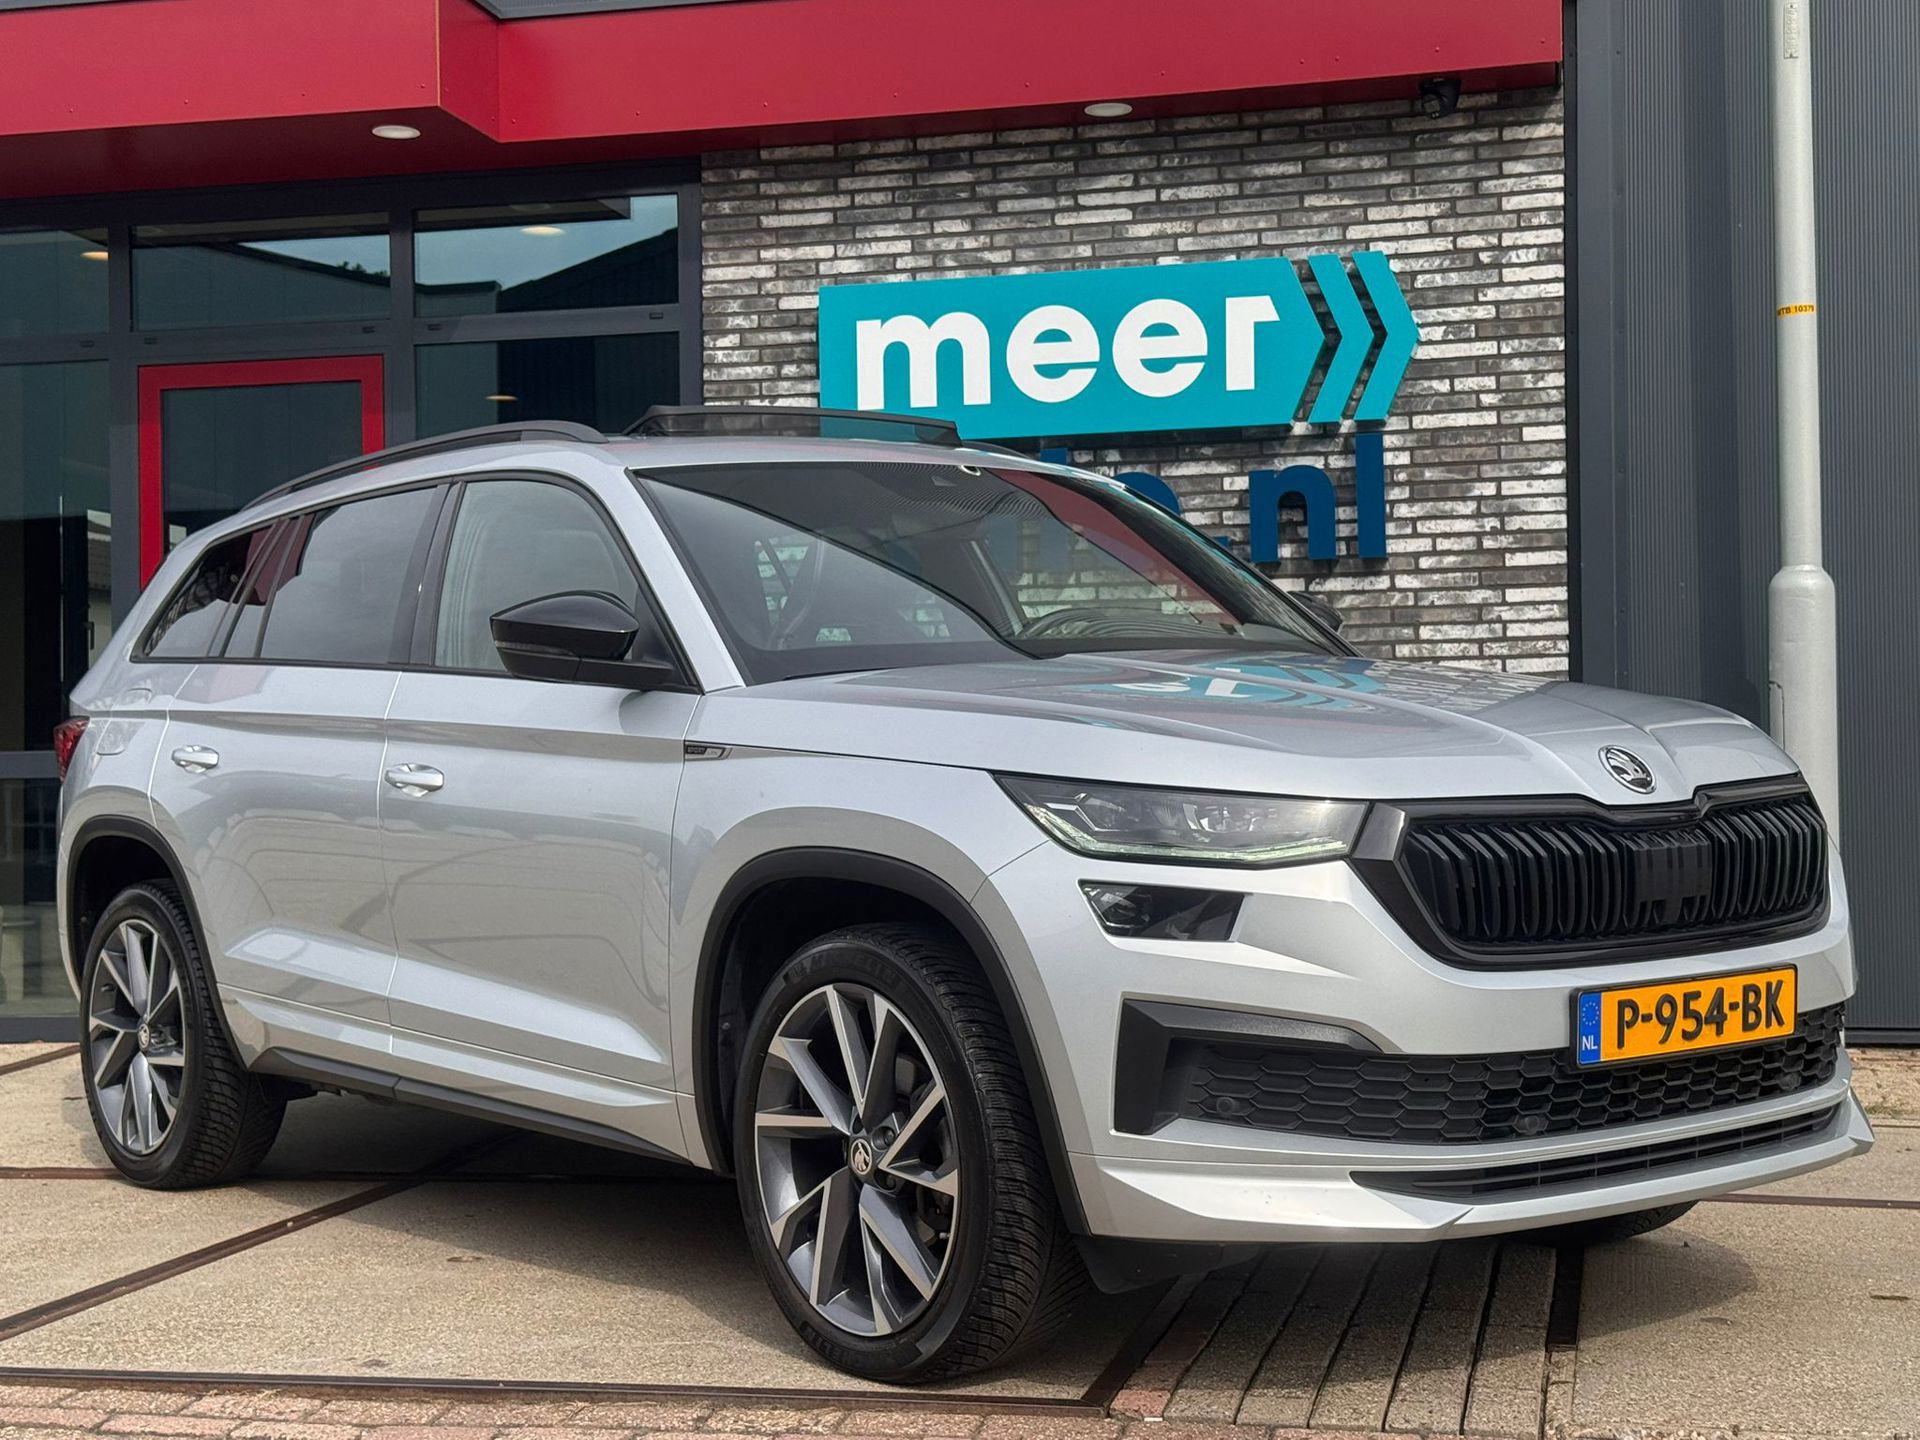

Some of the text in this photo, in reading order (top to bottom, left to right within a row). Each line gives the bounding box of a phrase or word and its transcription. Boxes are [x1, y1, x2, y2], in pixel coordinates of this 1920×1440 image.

[856, 295, 1281, 411] meer
[1581, 1034, 1599, 1051] NL
[1616, 979, 1786, 1050] P-954-BK
